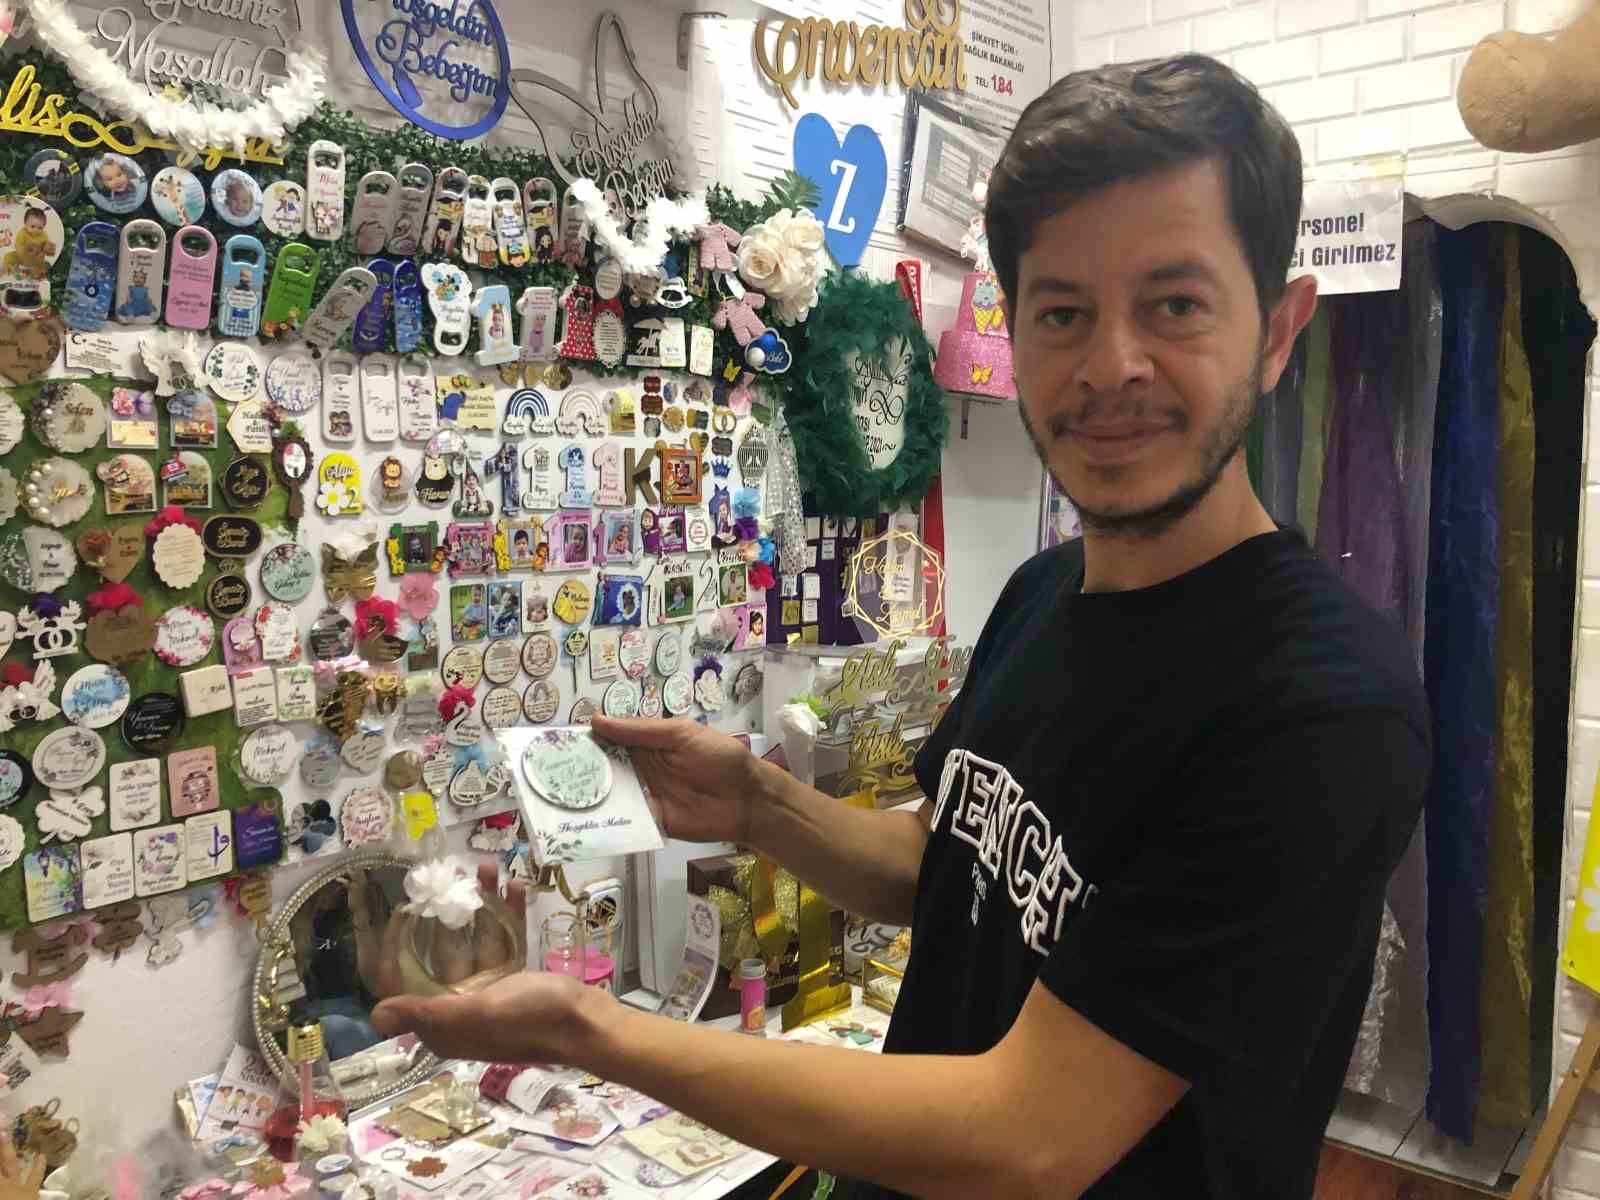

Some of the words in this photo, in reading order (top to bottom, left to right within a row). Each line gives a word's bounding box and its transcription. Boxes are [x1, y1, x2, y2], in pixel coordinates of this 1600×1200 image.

[991, 73, 1014, 96] 184
[826, 159, 857, 233] Z
[1311, 242, 1396, 267] Girilmez
